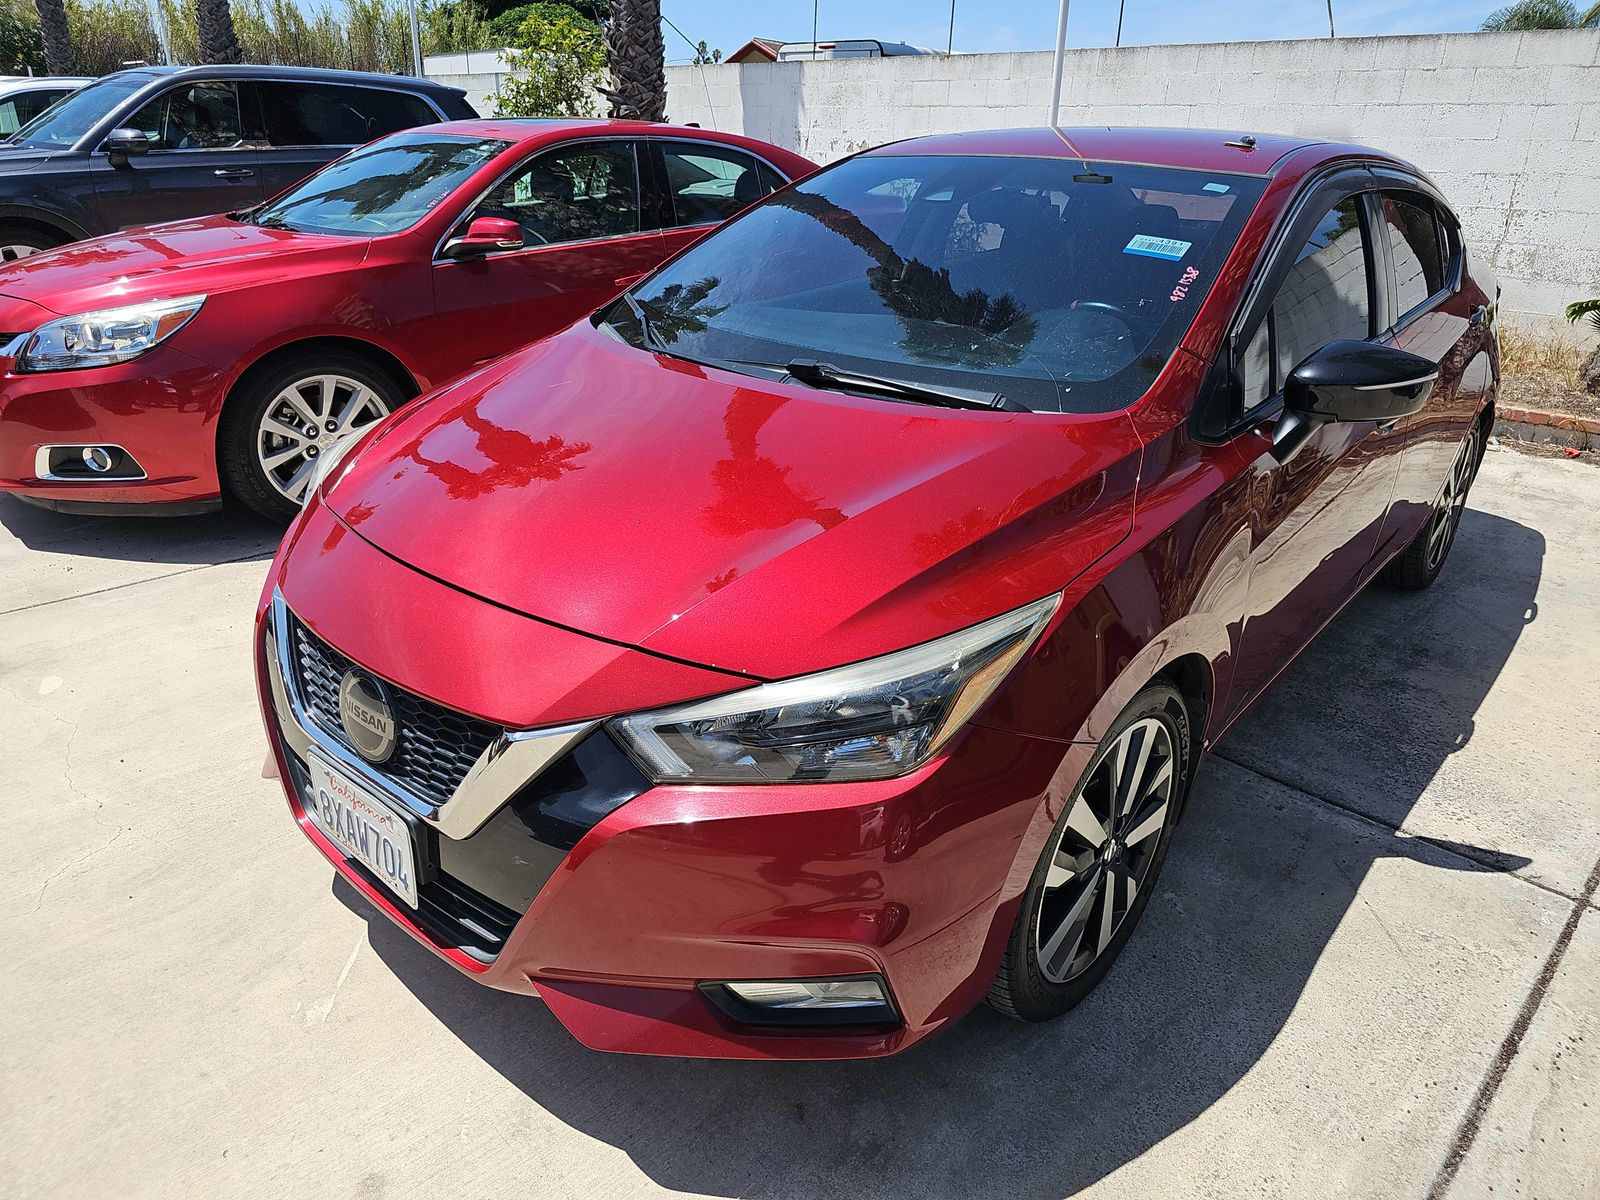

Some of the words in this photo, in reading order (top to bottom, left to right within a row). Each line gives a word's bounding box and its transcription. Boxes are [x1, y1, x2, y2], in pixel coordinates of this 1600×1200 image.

[345, 695, 387, 733] NISSAN
[329, 773, 387, 826] California
[319, 789, 411, 893] 8XAW704
